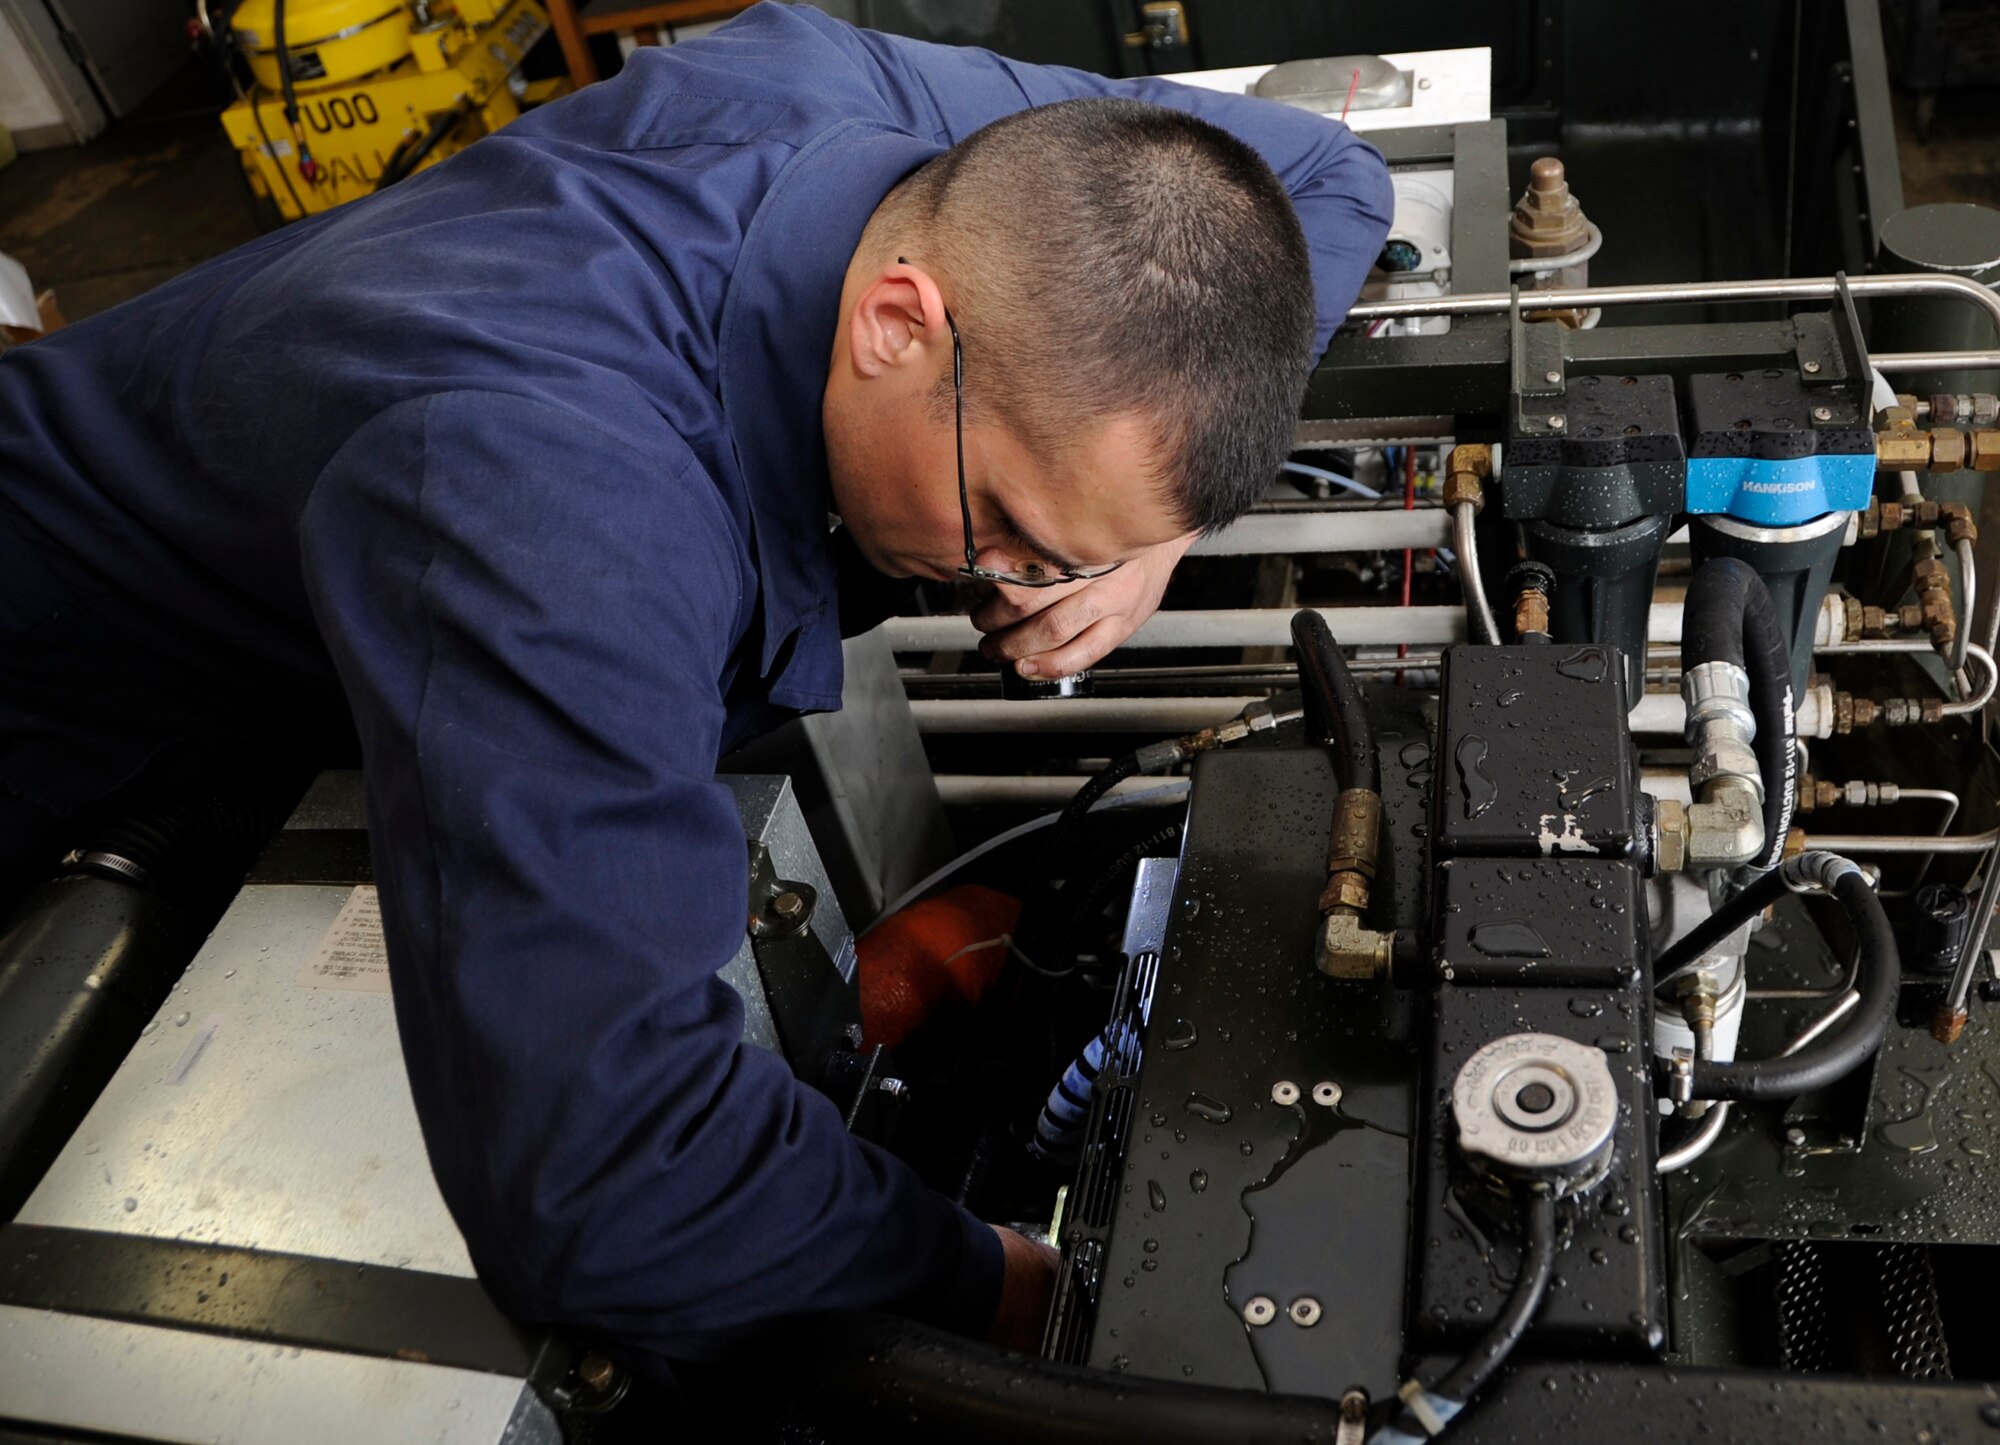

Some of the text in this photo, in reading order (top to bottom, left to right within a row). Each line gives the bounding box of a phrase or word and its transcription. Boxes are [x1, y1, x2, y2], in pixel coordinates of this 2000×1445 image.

[1742, 479, 1816, 495] HANKISON
[1778, 778, 1795, 834] SUCTION
[1134, 826, 1176, 855] 811-12
